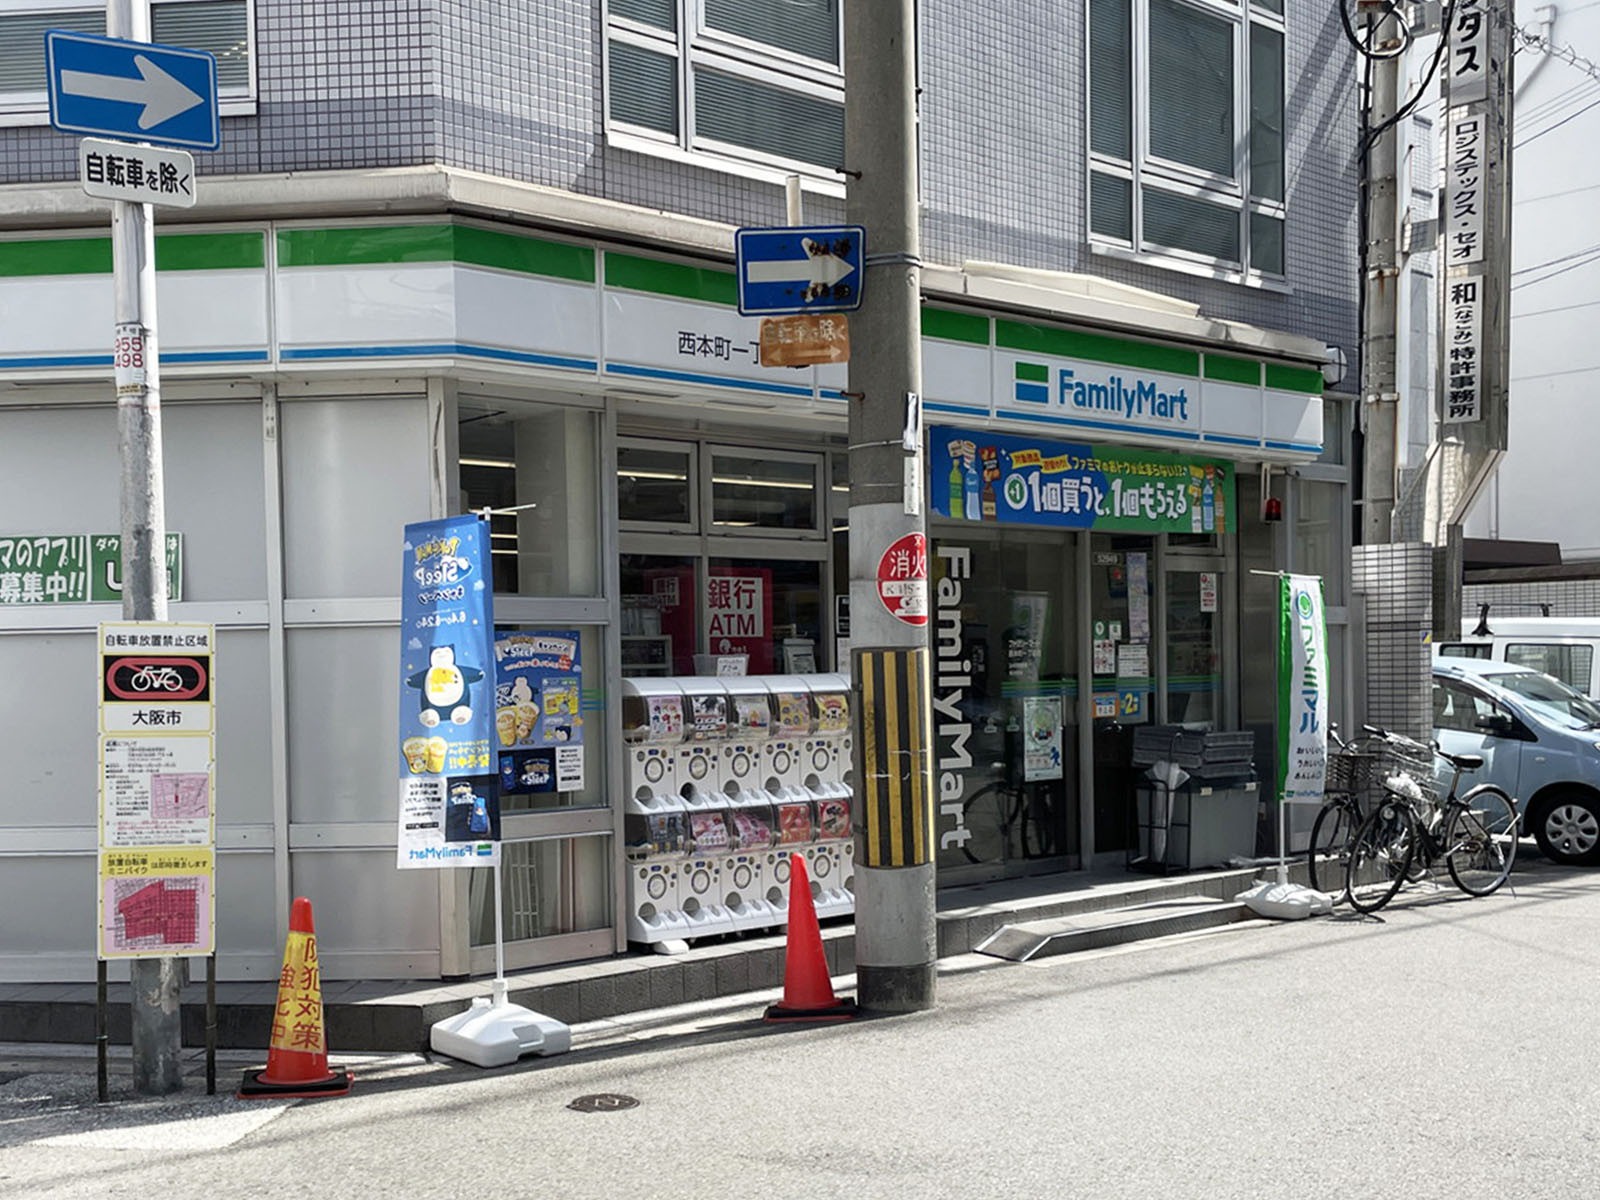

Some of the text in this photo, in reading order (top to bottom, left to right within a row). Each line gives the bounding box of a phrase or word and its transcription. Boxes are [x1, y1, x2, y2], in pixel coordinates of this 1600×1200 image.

[86, 151, 191, 196] 自転車を除く
[1059, 369, 1188, 420] FamilyMart
[708, 579, 756, 609] 銀行
[709, 614, 755, 635] ATM
[105, 634, 208, 647] 自転車放置禁止区域
[934, 547, 973, 850] FamilyMart
[132, 710, 182, 725] 大阪市
